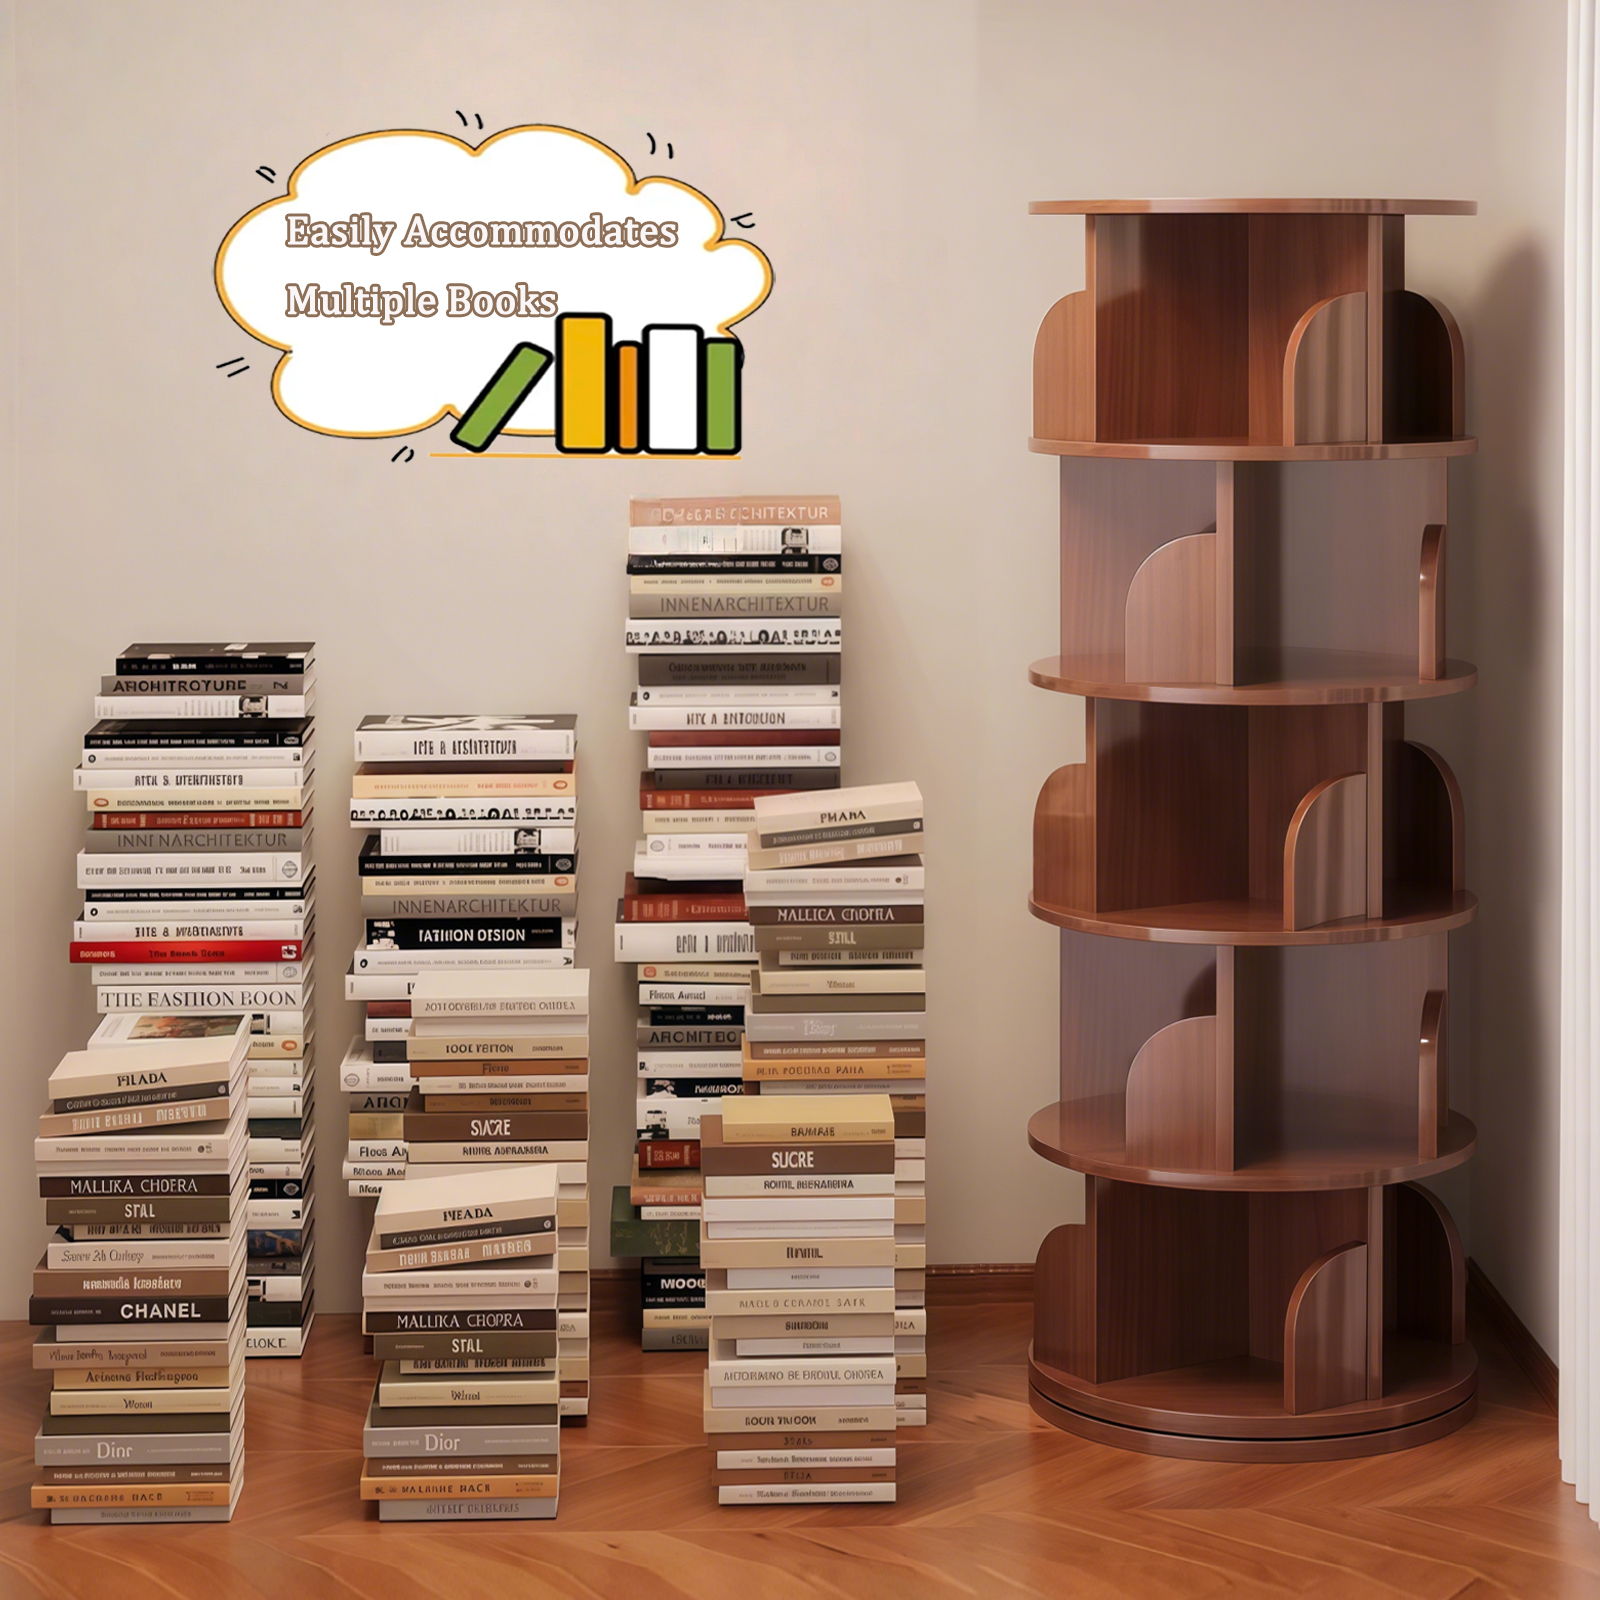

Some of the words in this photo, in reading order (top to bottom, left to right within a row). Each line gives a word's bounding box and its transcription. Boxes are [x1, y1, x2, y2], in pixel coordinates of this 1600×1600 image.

[393, 899, 561, 914] INNENARCHITEKTUR
[771, 1151, 815, 1169] SUCRE
[120, 1303, 202, 1319] CHANEL
[424, 1432, 461, 1452] Dior
